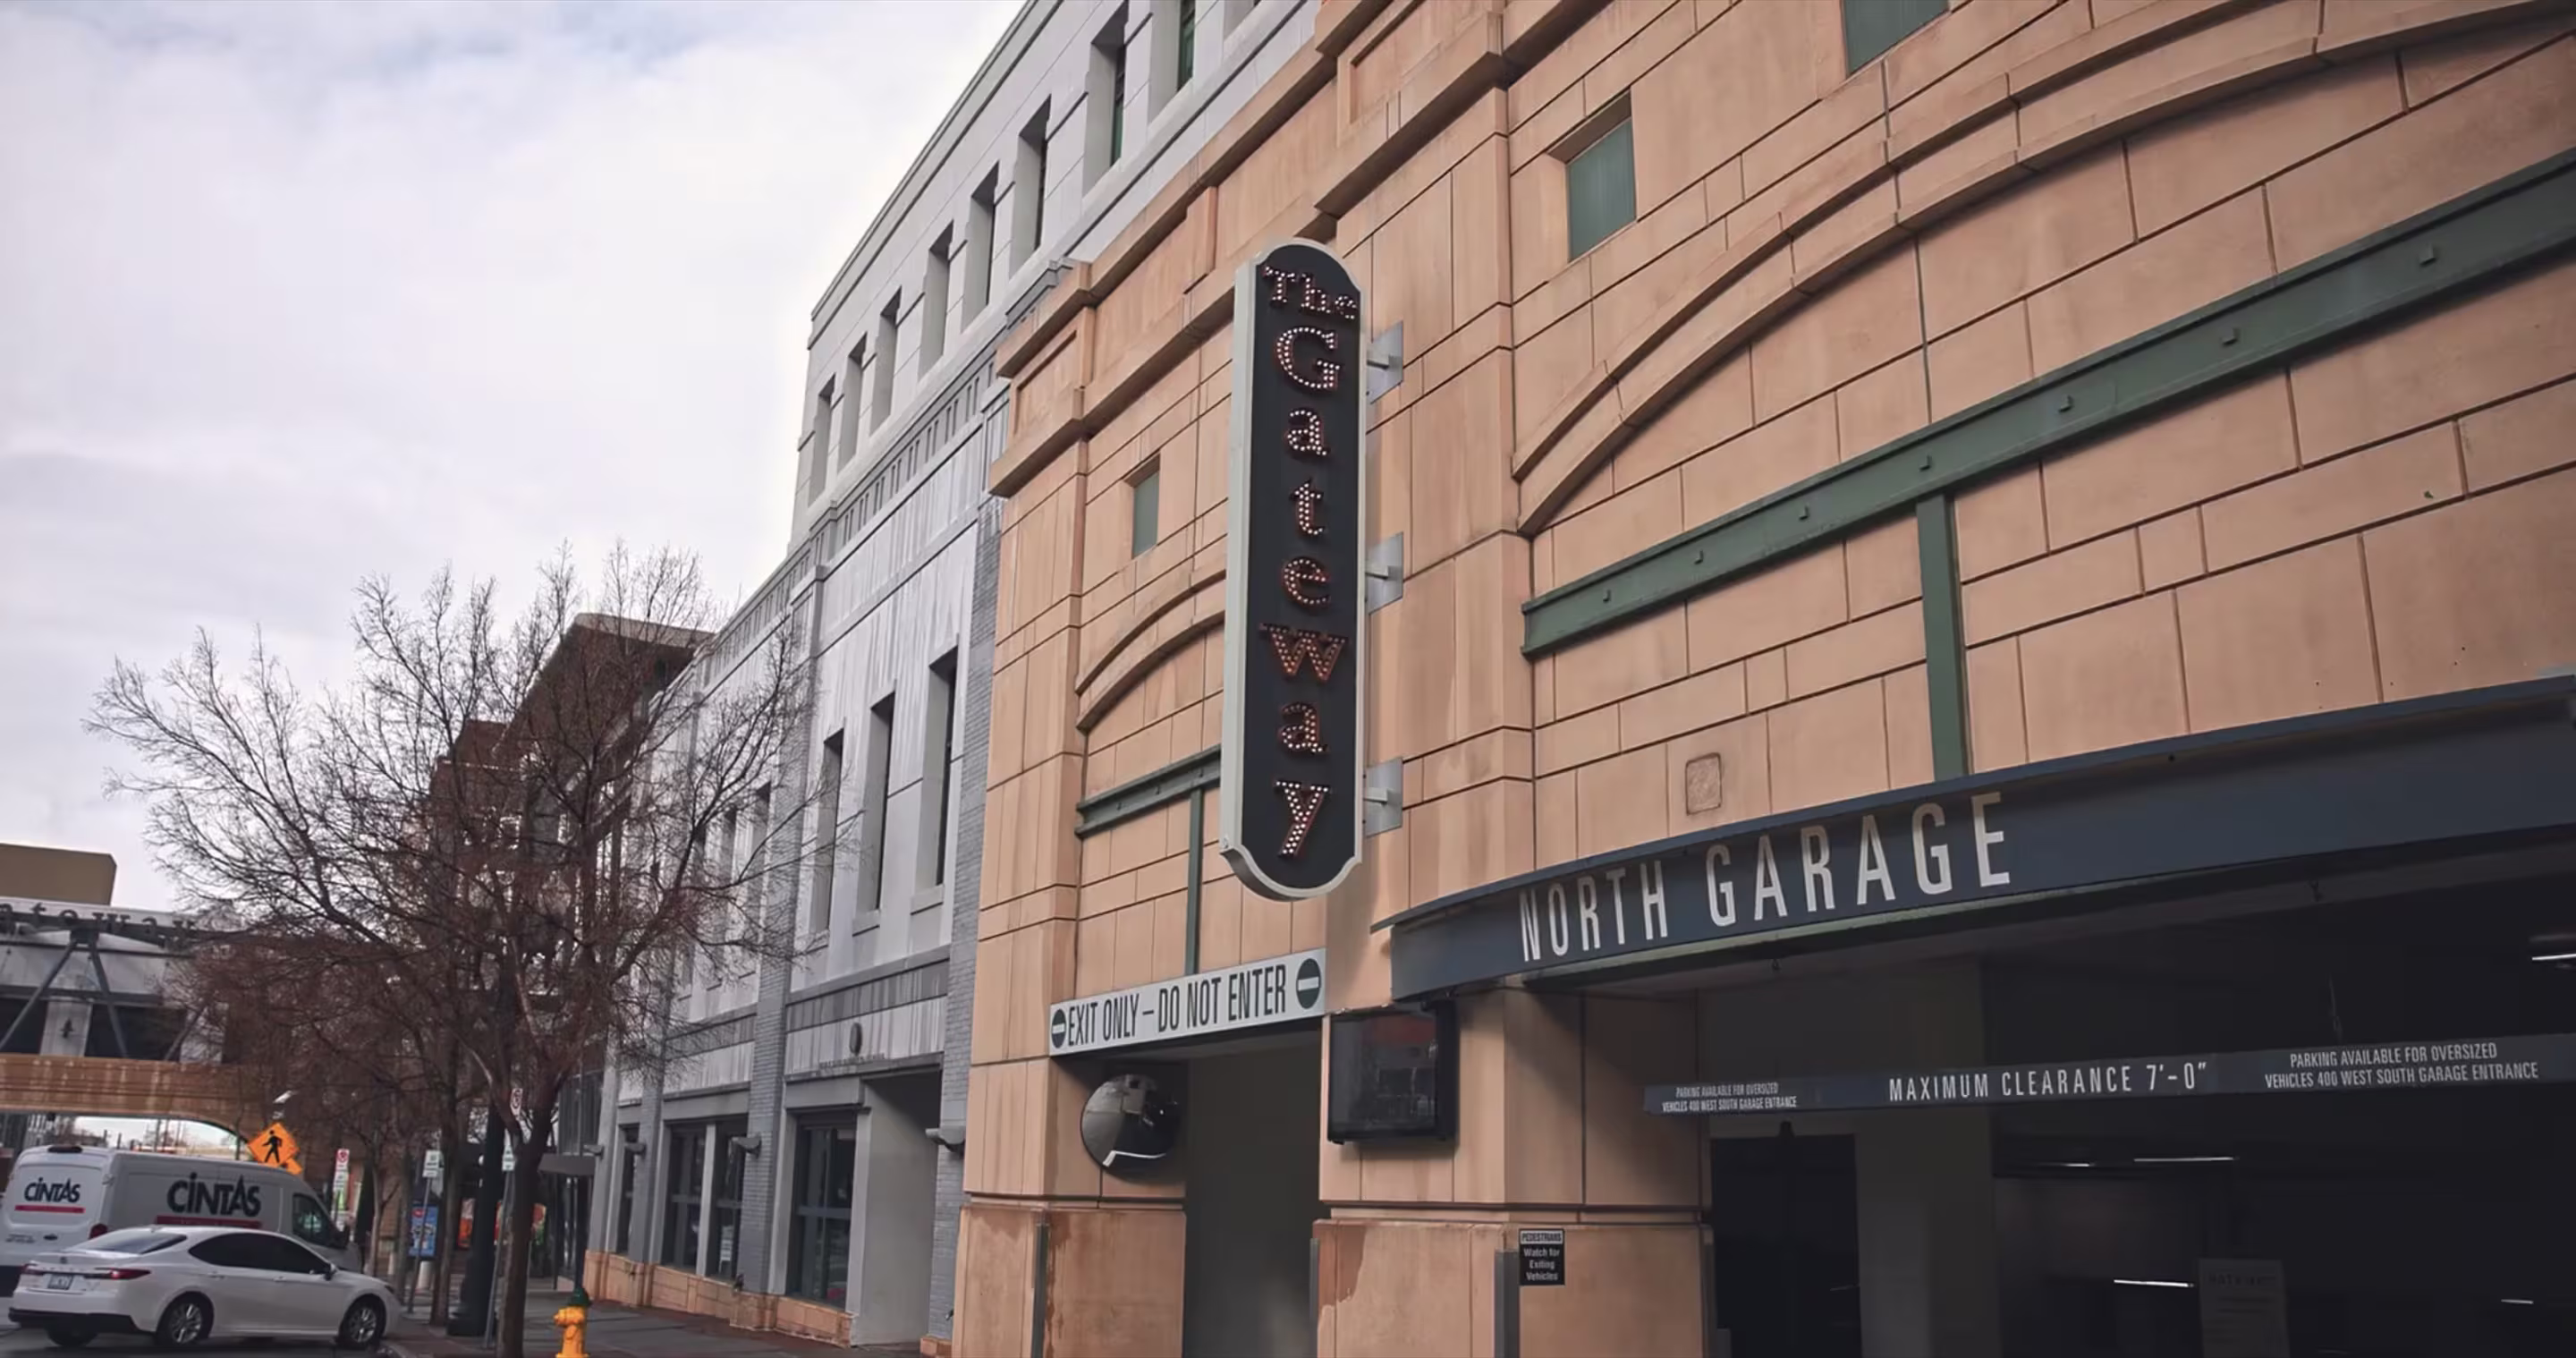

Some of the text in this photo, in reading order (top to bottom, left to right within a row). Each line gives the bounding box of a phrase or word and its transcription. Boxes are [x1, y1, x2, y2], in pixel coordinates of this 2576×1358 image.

[1264, 267, 1358, 321] The
[1259, 326, 1349, 856] Gateway
[1521, 792, 2011, 962] NORTH GARAGE
[1068, 1002, 1098, 1046] EXIT
[1103, 993, 1140, 1041] ONLY
[1158, 986, 1181, 1032] DO
[1187, 977, 1222, 1029] NOT
[1228, 964, 1287, 1022] ENTER
[2290, 1042, 2497, 1068] PARKING AVAILABLE FOR OVERSIZED
[1889, 1074, 1989, 1101] MAXIMUM
[2002, 1065, 2132, 1097] CLEARANCE
[2265, 1062, 2538, 1089] VEHICLES 400 WEST SOUTH GARAGE ENTRANCE
[1675, 1082, 1778, 1098] PARKING AVAILABLE FOR OVERSIZED
[1662, 1100, 1688, 1112] VEHICLES
[1701, 1099, 1717, 1111] WEST
[1718, 1098, 1738, 1110] SOUTH
[1739, 1097, 1764, 1109] GARAGE
[1765, 1096, 1797, 1108] ENTRANCE
[1523, 1248, 1560, 1257] Watch for
[1529, 1260, 1555, 1269] Exiting
[1525, 1272, 1558, 1281] Vehicles
